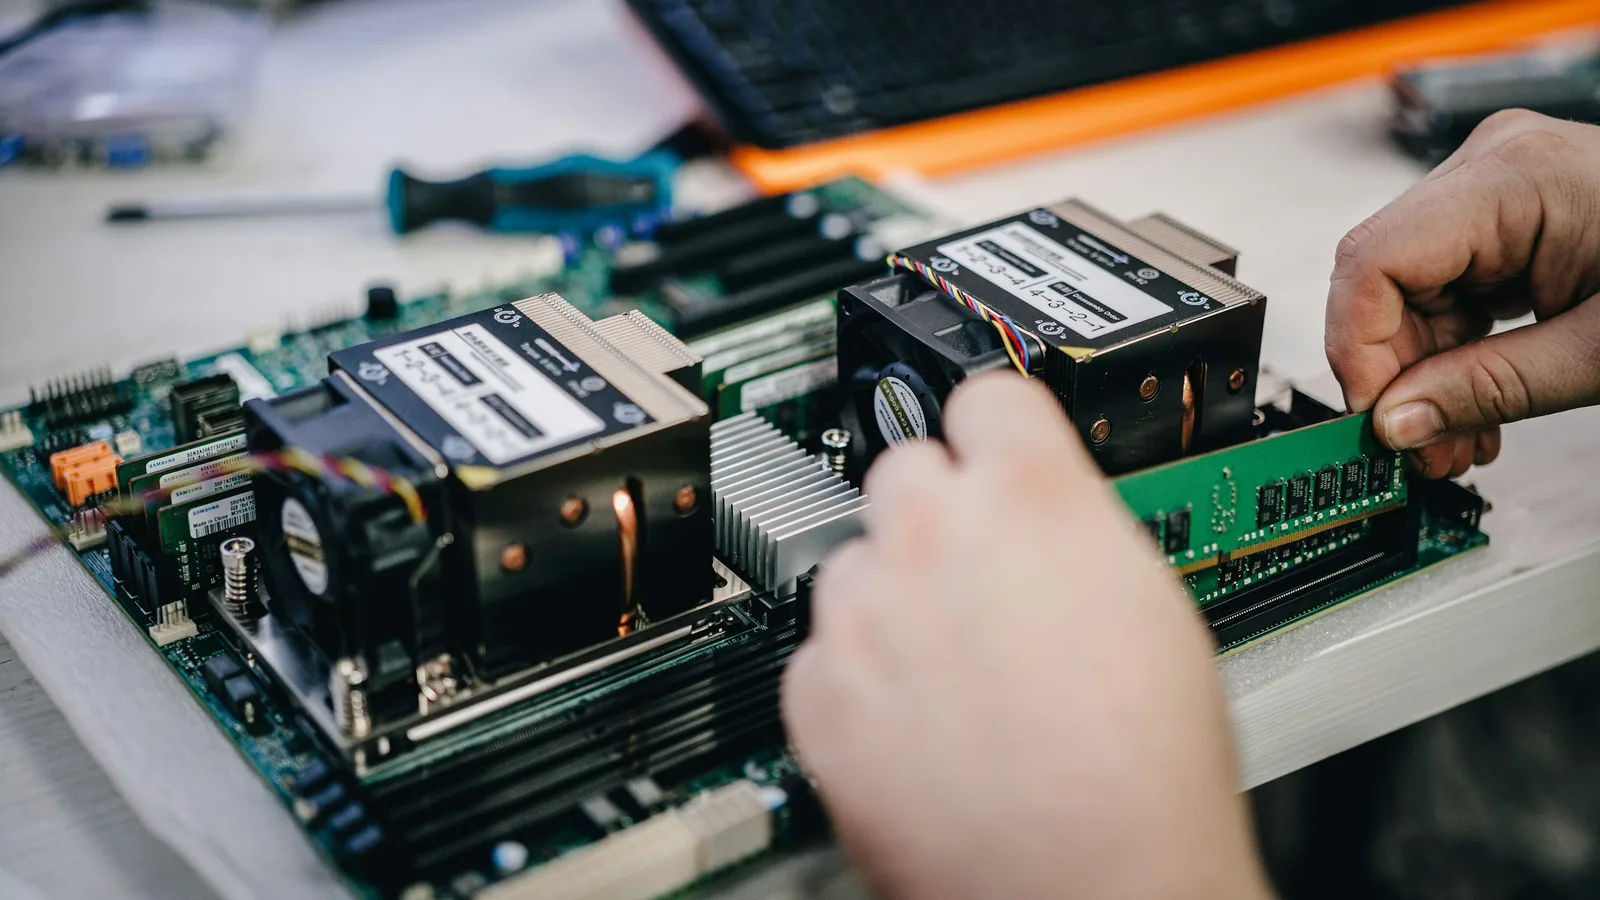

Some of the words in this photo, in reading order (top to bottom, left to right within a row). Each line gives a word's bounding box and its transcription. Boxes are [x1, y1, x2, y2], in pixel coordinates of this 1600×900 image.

[882, 383, 899, 411] COOLER
[898, 412, 907, 427] CPU
[149, 457, 176, 469] SAMSUNG
[163, 471, 191, 483] SAMSUNG
[175, 485, 203, 497] SAMSUNG
[192, 504, 220, 516] SAMSUNG
